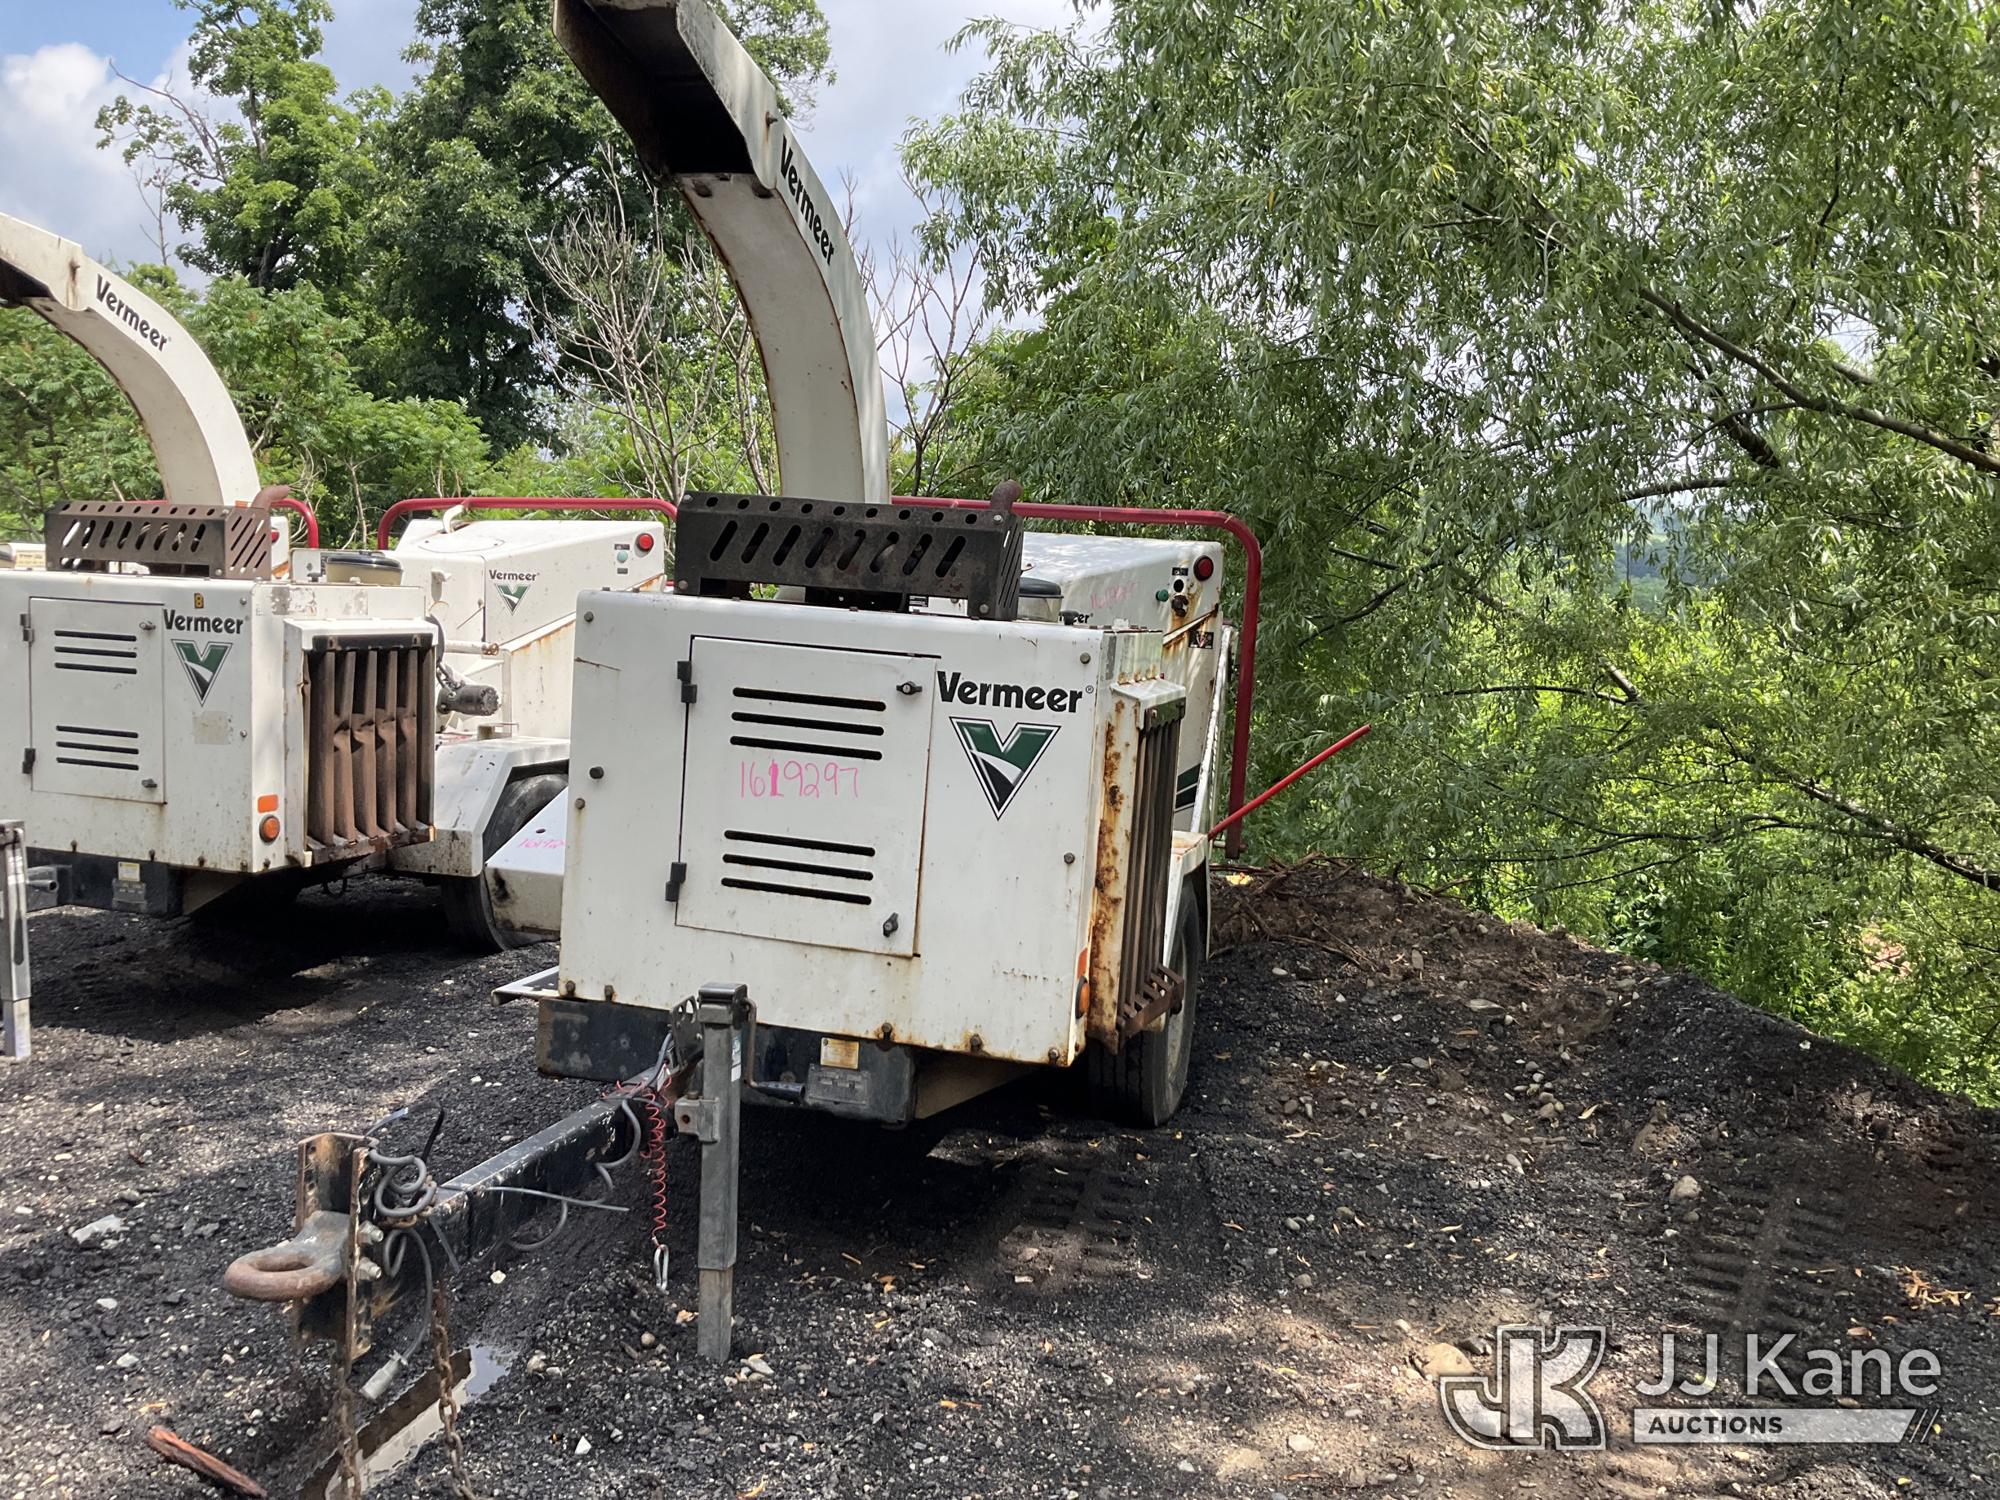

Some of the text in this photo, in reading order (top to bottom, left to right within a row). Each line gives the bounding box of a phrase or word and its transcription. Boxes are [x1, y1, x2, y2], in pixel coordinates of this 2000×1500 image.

[781, 135, 835, 266] Vermeer
[96, 273, 168, 352] Vermeer
[489, 569, 537, 581] Vermeer
[163, 609, 243, 634] Vermeer
[937, 670, 1083, 713] Vermeer
[740, 759, 858, 798] 1619297
